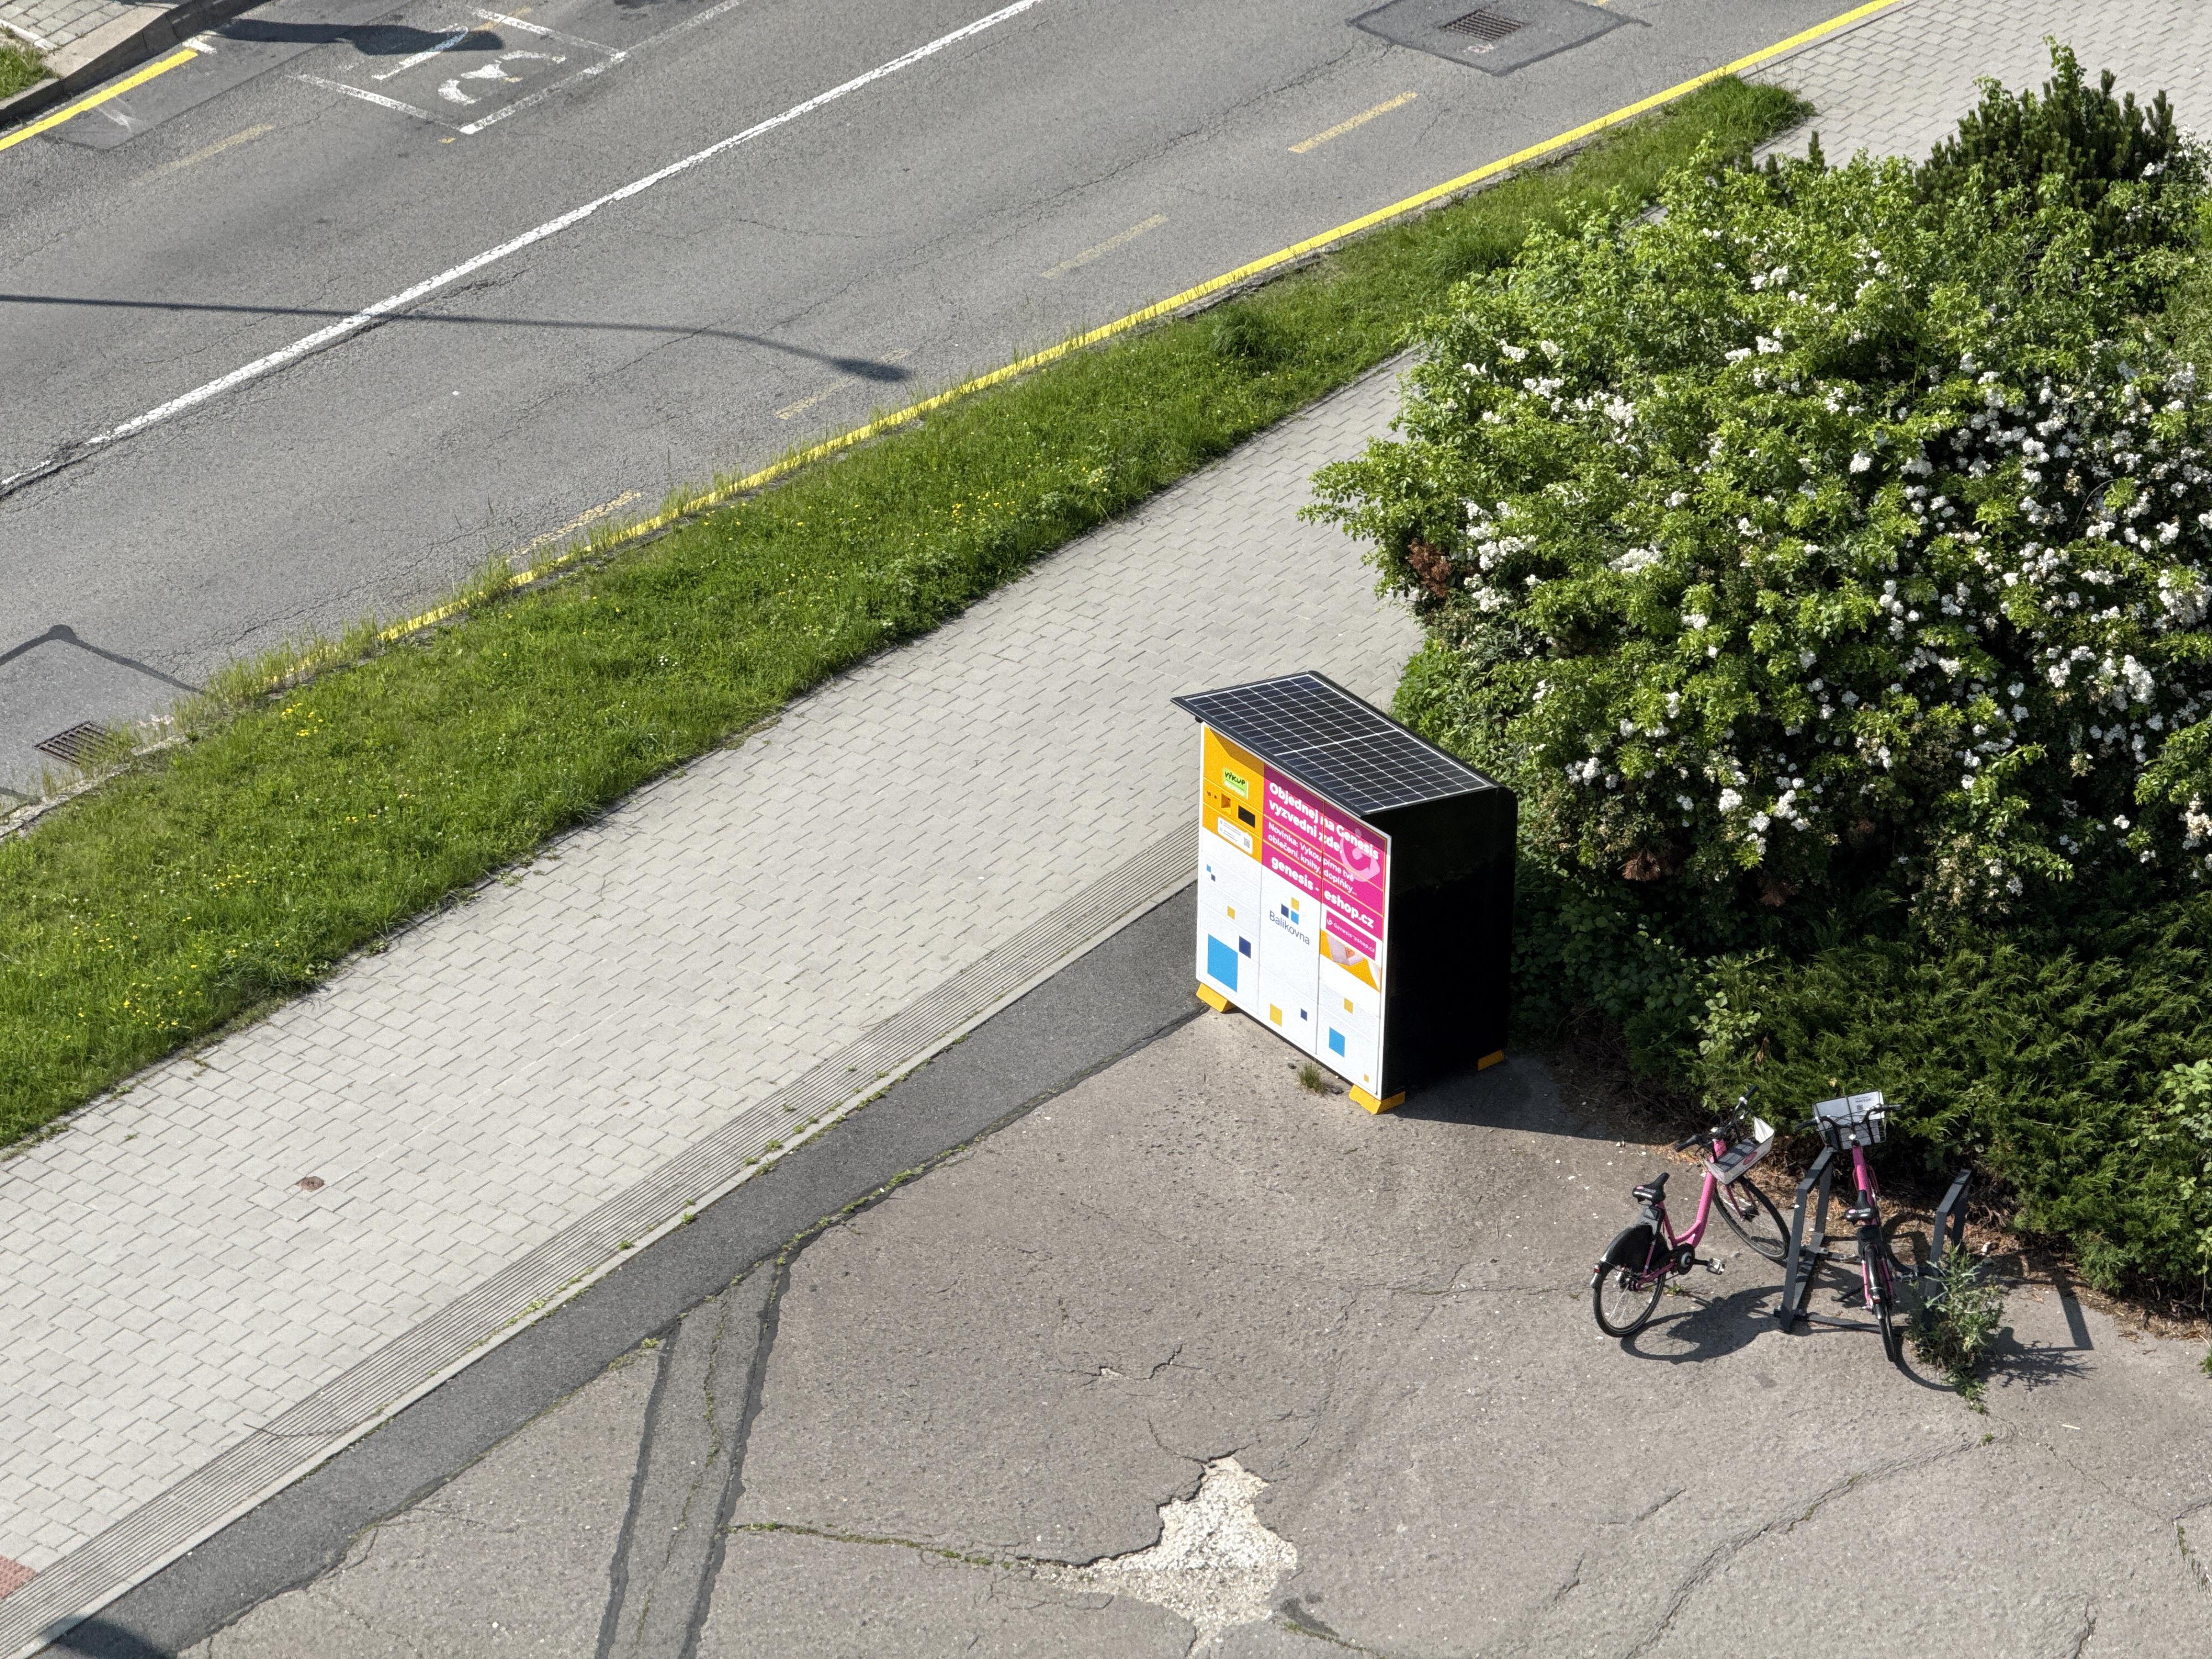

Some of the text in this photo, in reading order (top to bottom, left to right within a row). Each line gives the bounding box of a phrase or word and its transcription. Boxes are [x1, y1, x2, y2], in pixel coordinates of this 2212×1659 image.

[1269, 800, 1317, 838] vyzvedni
[1269, 782, 1379, 860] Objednej na Genesis
[1269, 822, 1298, 847] Novinka:
[1271, 857, 1313, 891] genesis
[1324, 890, 1374, 929] eshop.cz
[1269, 910, 1310, 946] Balíkovna
